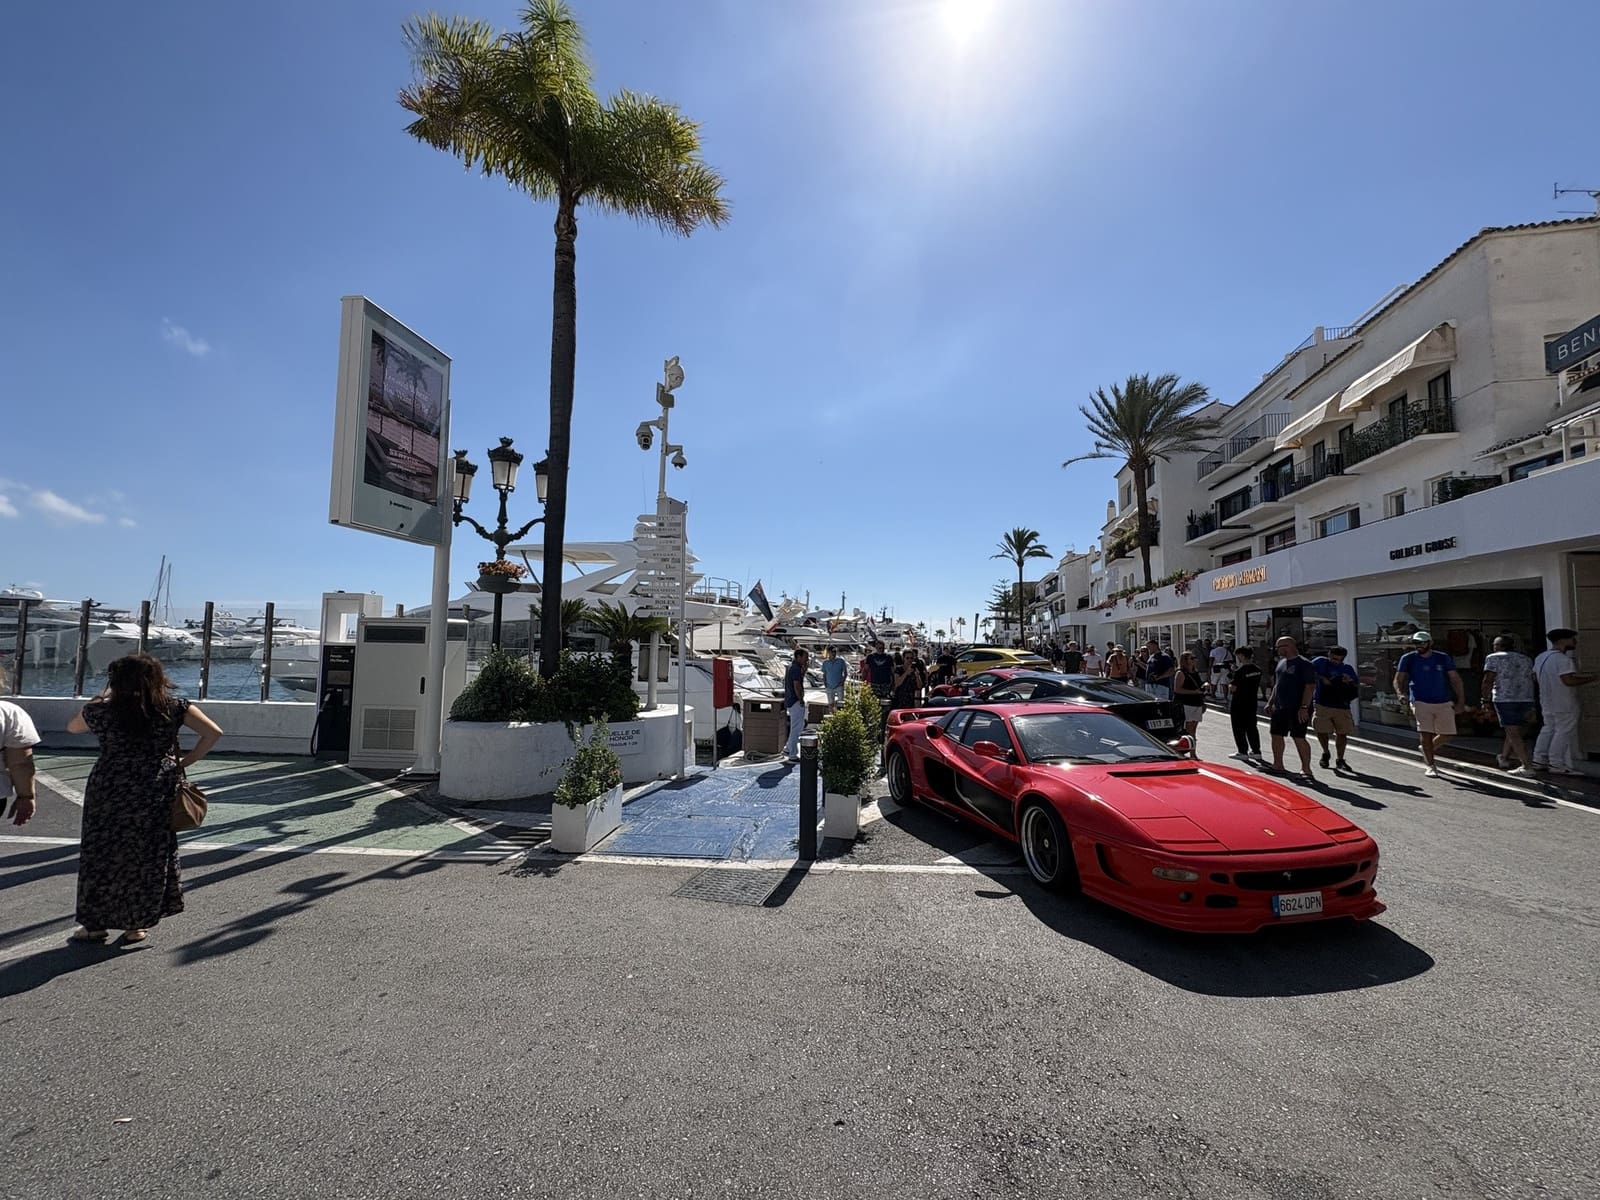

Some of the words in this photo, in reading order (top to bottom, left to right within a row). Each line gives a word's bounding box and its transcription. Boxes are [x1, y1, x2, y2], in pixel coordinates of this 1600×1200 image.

[1557, 327, 1600, 360] BEN
[1389, 544, 1423, 560] GOLDEN
[1425, 536, 1457, 553] GOOSE
[1239, 564, 1268, 585] ARMANI
[1280, 897, 1303, 912] 6624
